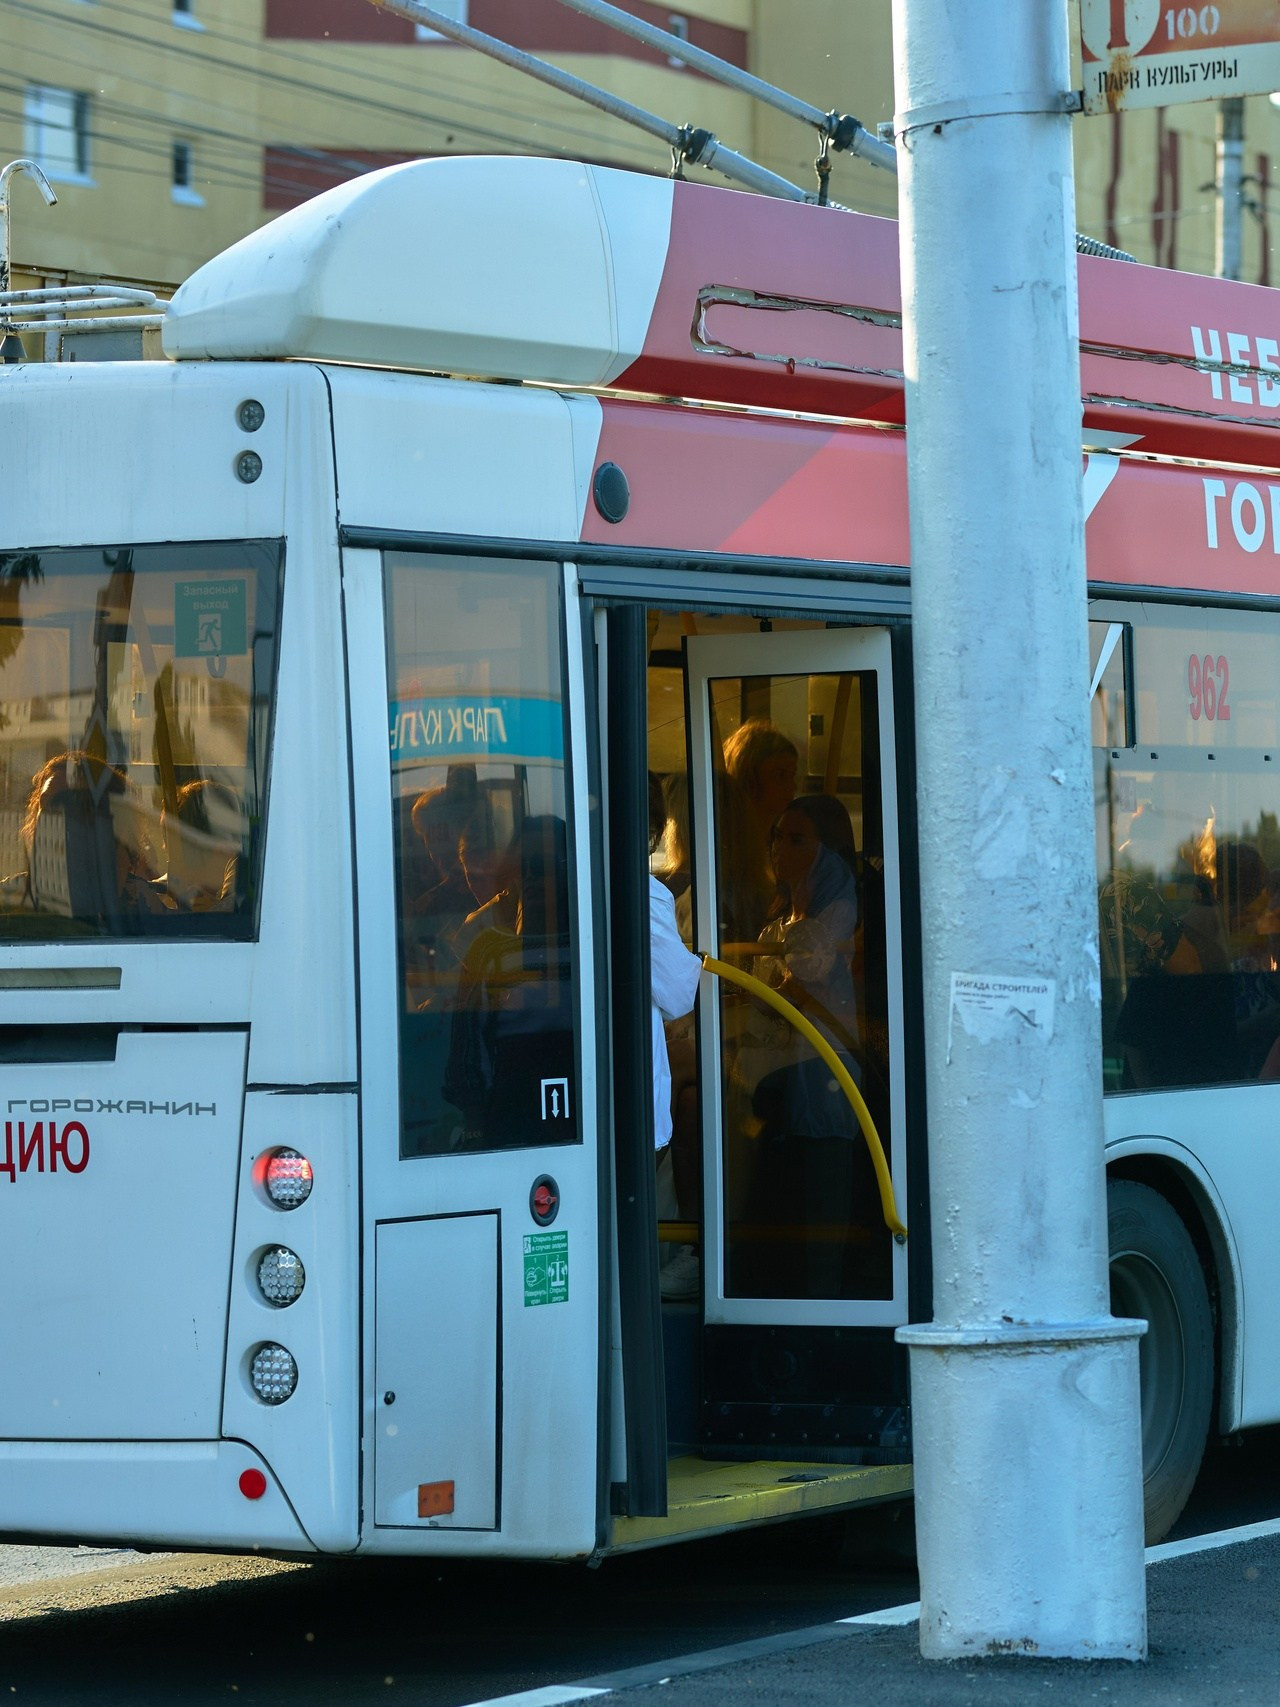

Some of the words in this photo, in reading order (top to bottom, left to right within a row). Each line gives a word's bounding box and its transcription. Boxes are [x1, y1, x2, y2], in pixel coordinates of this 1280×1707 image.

[1165, 5, 1221, 41] 100
[1098, 69, 1140, 93] ПАРК
[1147, 58, 1238, 87] КУЛЬТУРЫ
[184, 584, 239, 596] Запасный
[193, 600, 229, 610] выход
[1188, 654, 1231, 721] 962
[992, 983, 1048, 993] СТРОИТЕЛЕЙ
[8, 1099, 217, 1116] ГОРОЖАНИН
